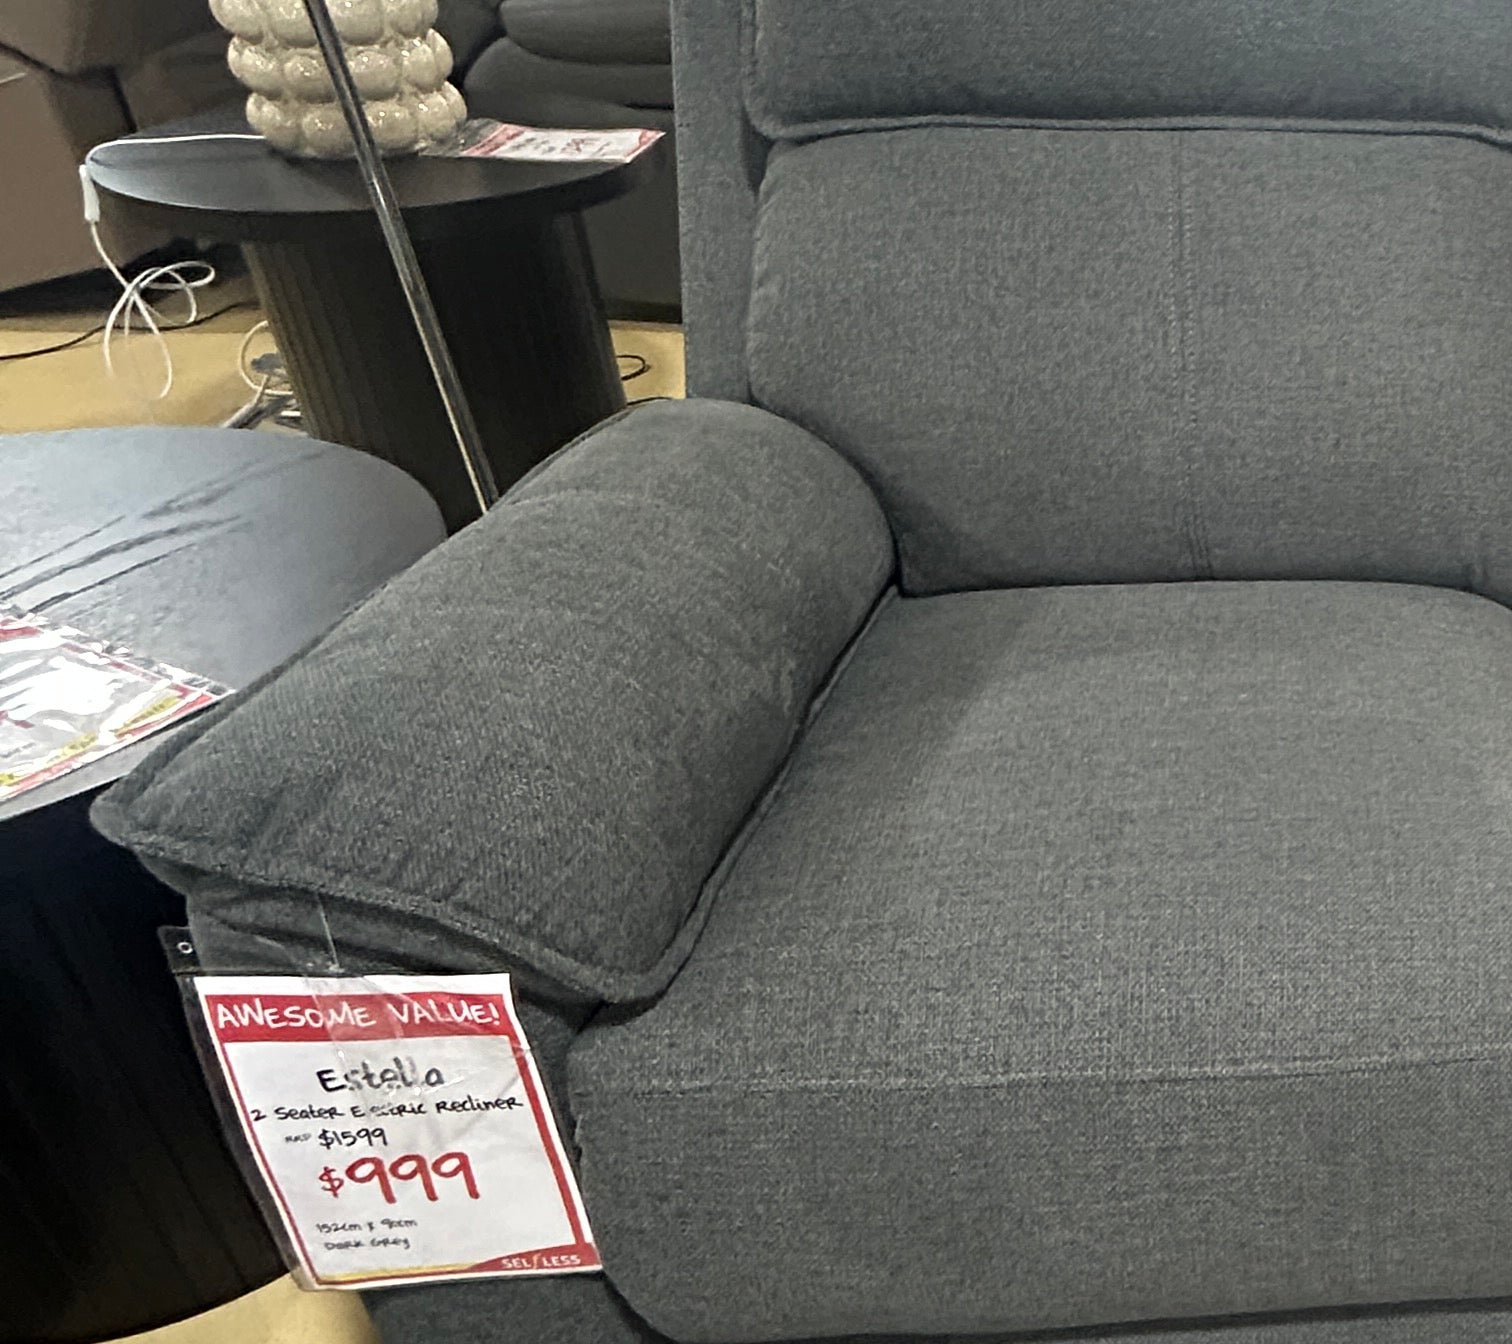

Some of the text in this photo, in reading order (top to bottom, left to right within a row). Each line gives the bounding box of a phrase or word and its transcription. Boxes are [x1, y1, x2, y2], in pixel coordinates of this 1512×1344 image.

[216, 997, 501, 1030] AWESOME VALUE!
[316, 1056, 446, 1093] Estella
[250, 1108, 267, 1123] 2
[318, 1127, 388, 1150] $1599
[318, 1151, 481, 1205] $999
